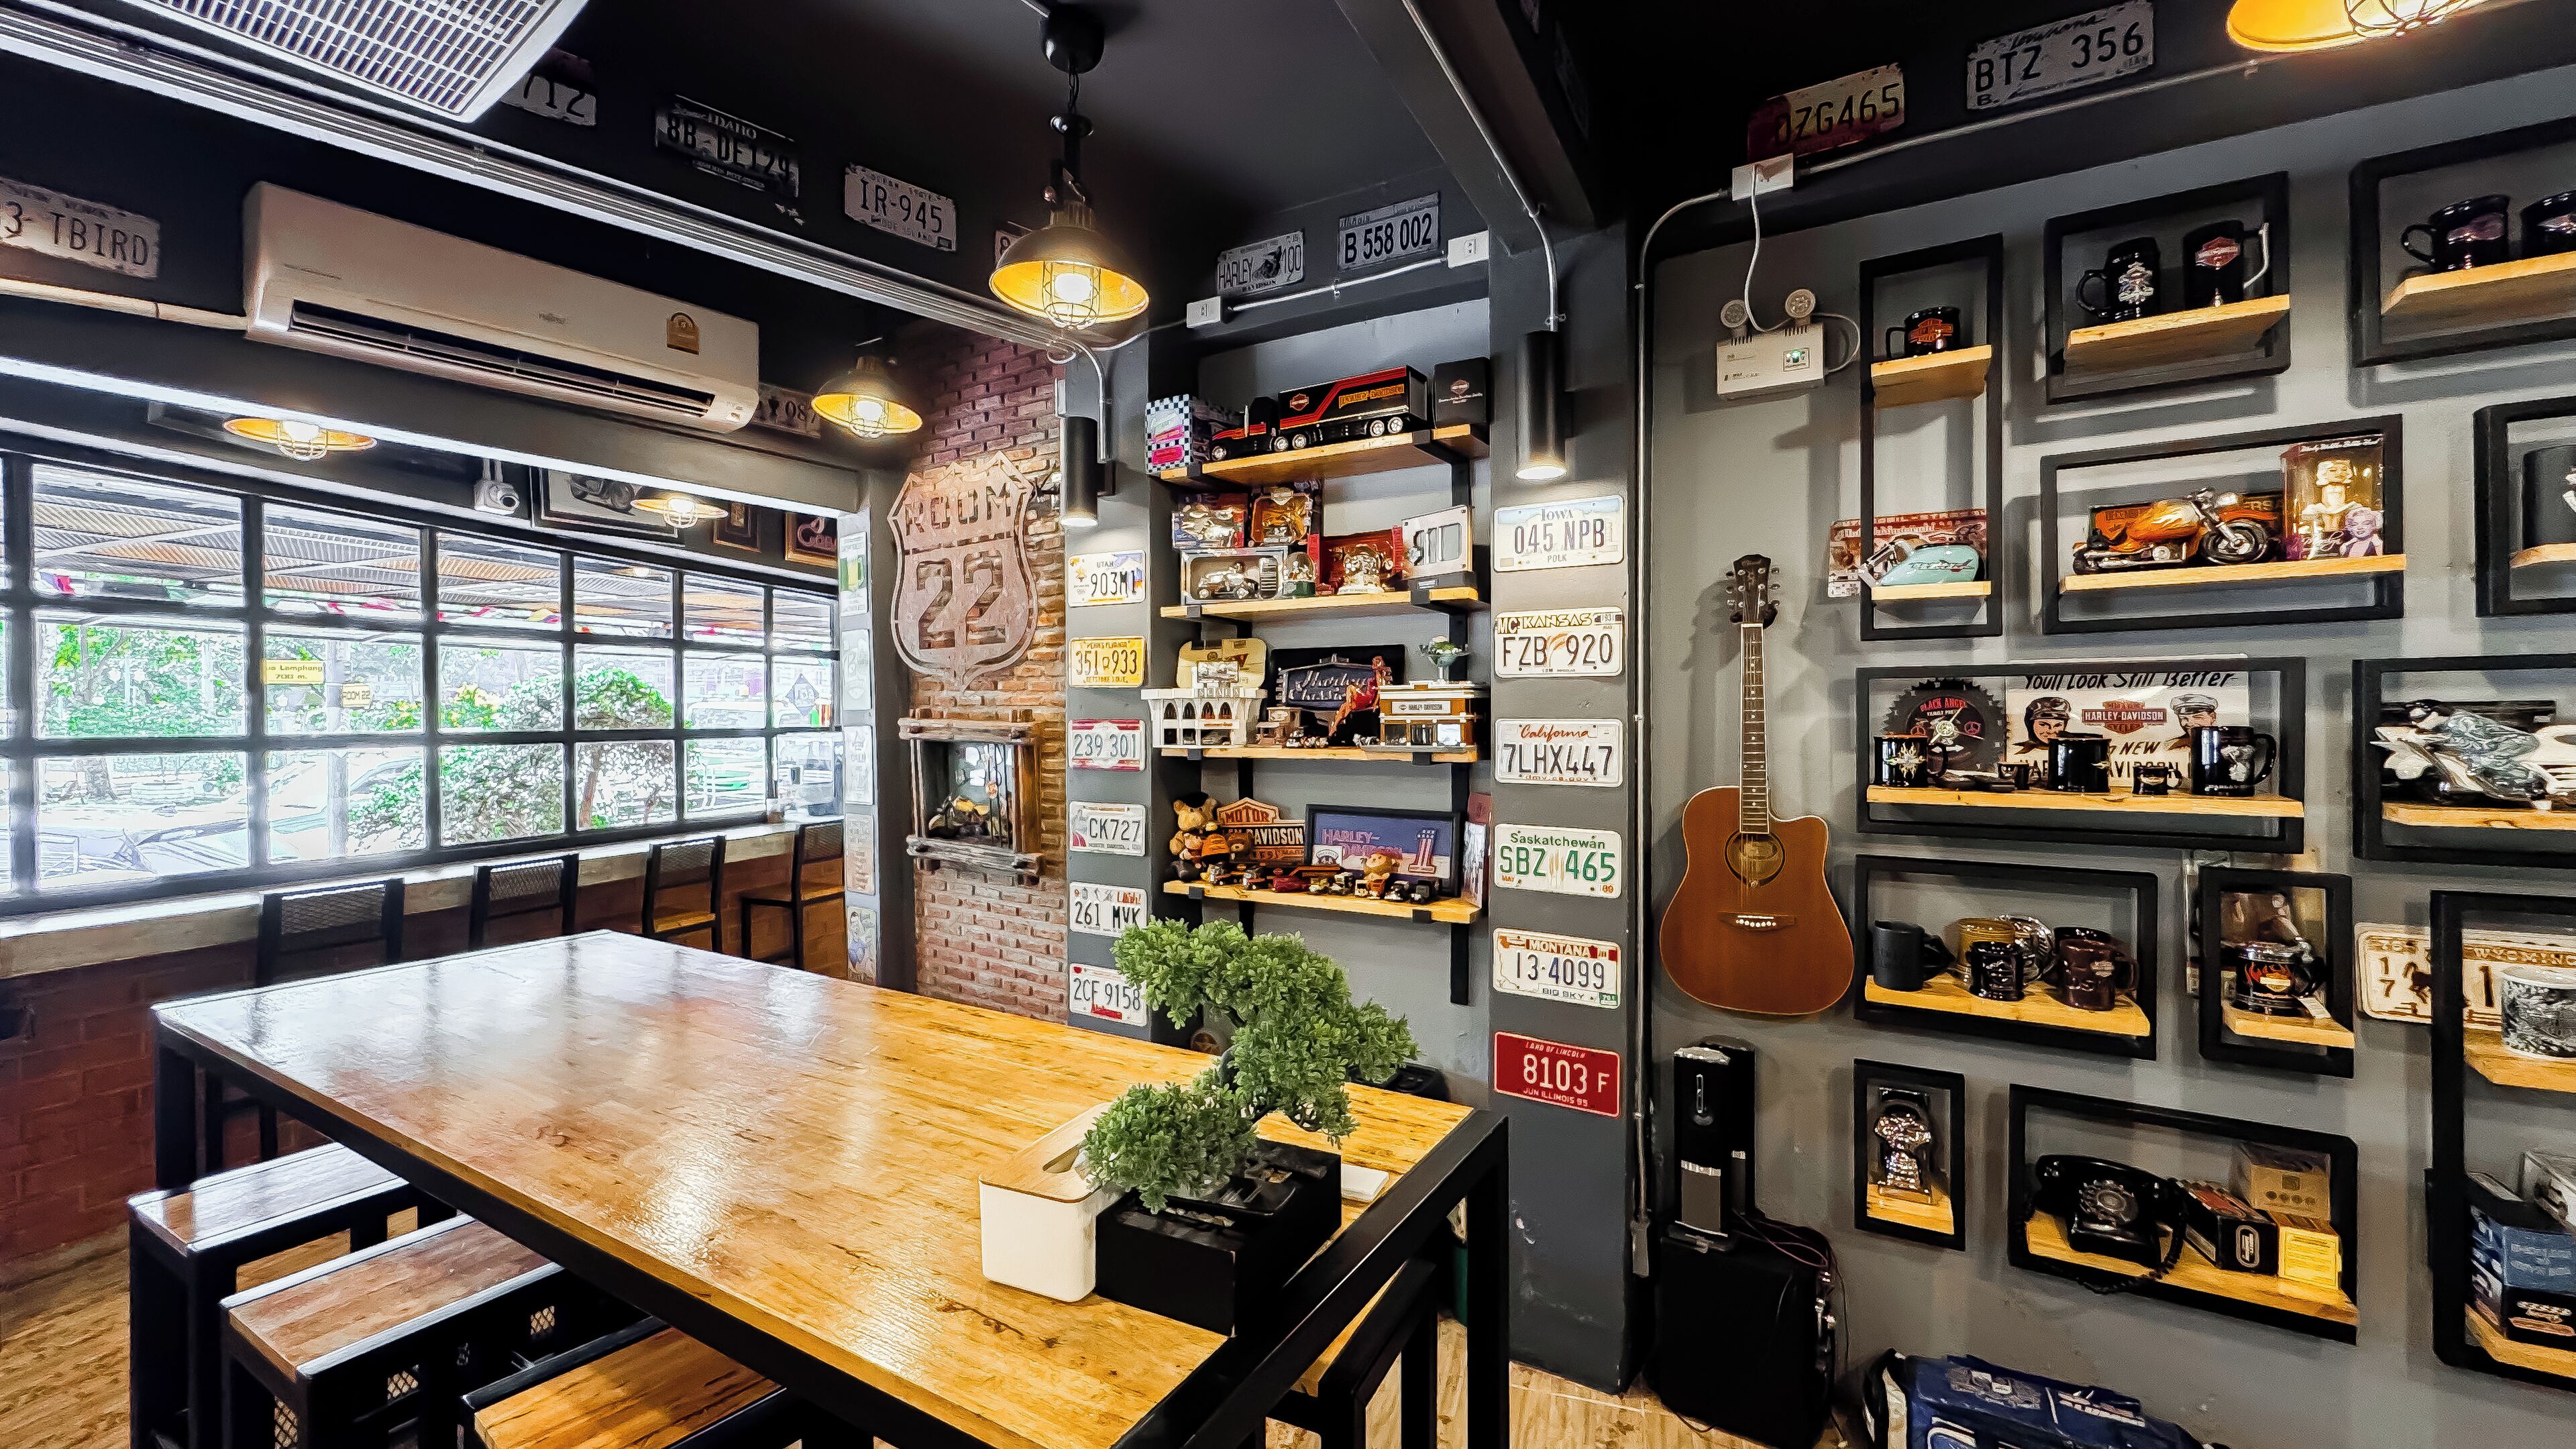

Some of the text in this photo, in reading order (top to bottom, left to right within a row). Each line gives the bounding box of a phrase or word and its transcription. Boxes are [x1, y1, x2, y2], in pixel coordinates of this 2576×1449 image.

[1975, 21, 2144, 93] BTZ 356
[861, 176, 943, 233] IR-945
[49, 211, 148, 266] TBIRD
[1345, 213, 1432, 264] B 558 002
[903, 484, 1011, 536] ROOM
[1564, 519, 1605, 551] NPB
[916, 548, 1007, 650] 22
[1522, 612, 1593, 629] KANSAS
[1075, 649, 1137, 676] 351 933
[1503, 633, 1613, 667] FZB 920
[2067, 673, 2107, 690] Look
[2163, 671, 2236, 688] Better
[2085, 711, 2164, 721] HARLEY-DAVIDSON
[1074, 733, 1136, 758] 239 301
[1521, 724, 1589, 742] California
[1503, 743, 1613, 776] 7LHX447
[2120, 741, 2161, 755] NEW
[1225, 806, 1269, 823] MOTOR
[1089, 818, 1141, 842] CK727
[1510, 833, 1605, 850] Saskatchewan
[1499, 845, 1616, 882] SBZ 465
[1075, 900, 1100, 926] 261
[1528, 939, 1592, 958] MONTANA
[1104, 983, 1141, 1011] 9158
[1542, 987, 1560, 996] BIG
[1523, 1053, 1610, 1094] 8103 F
